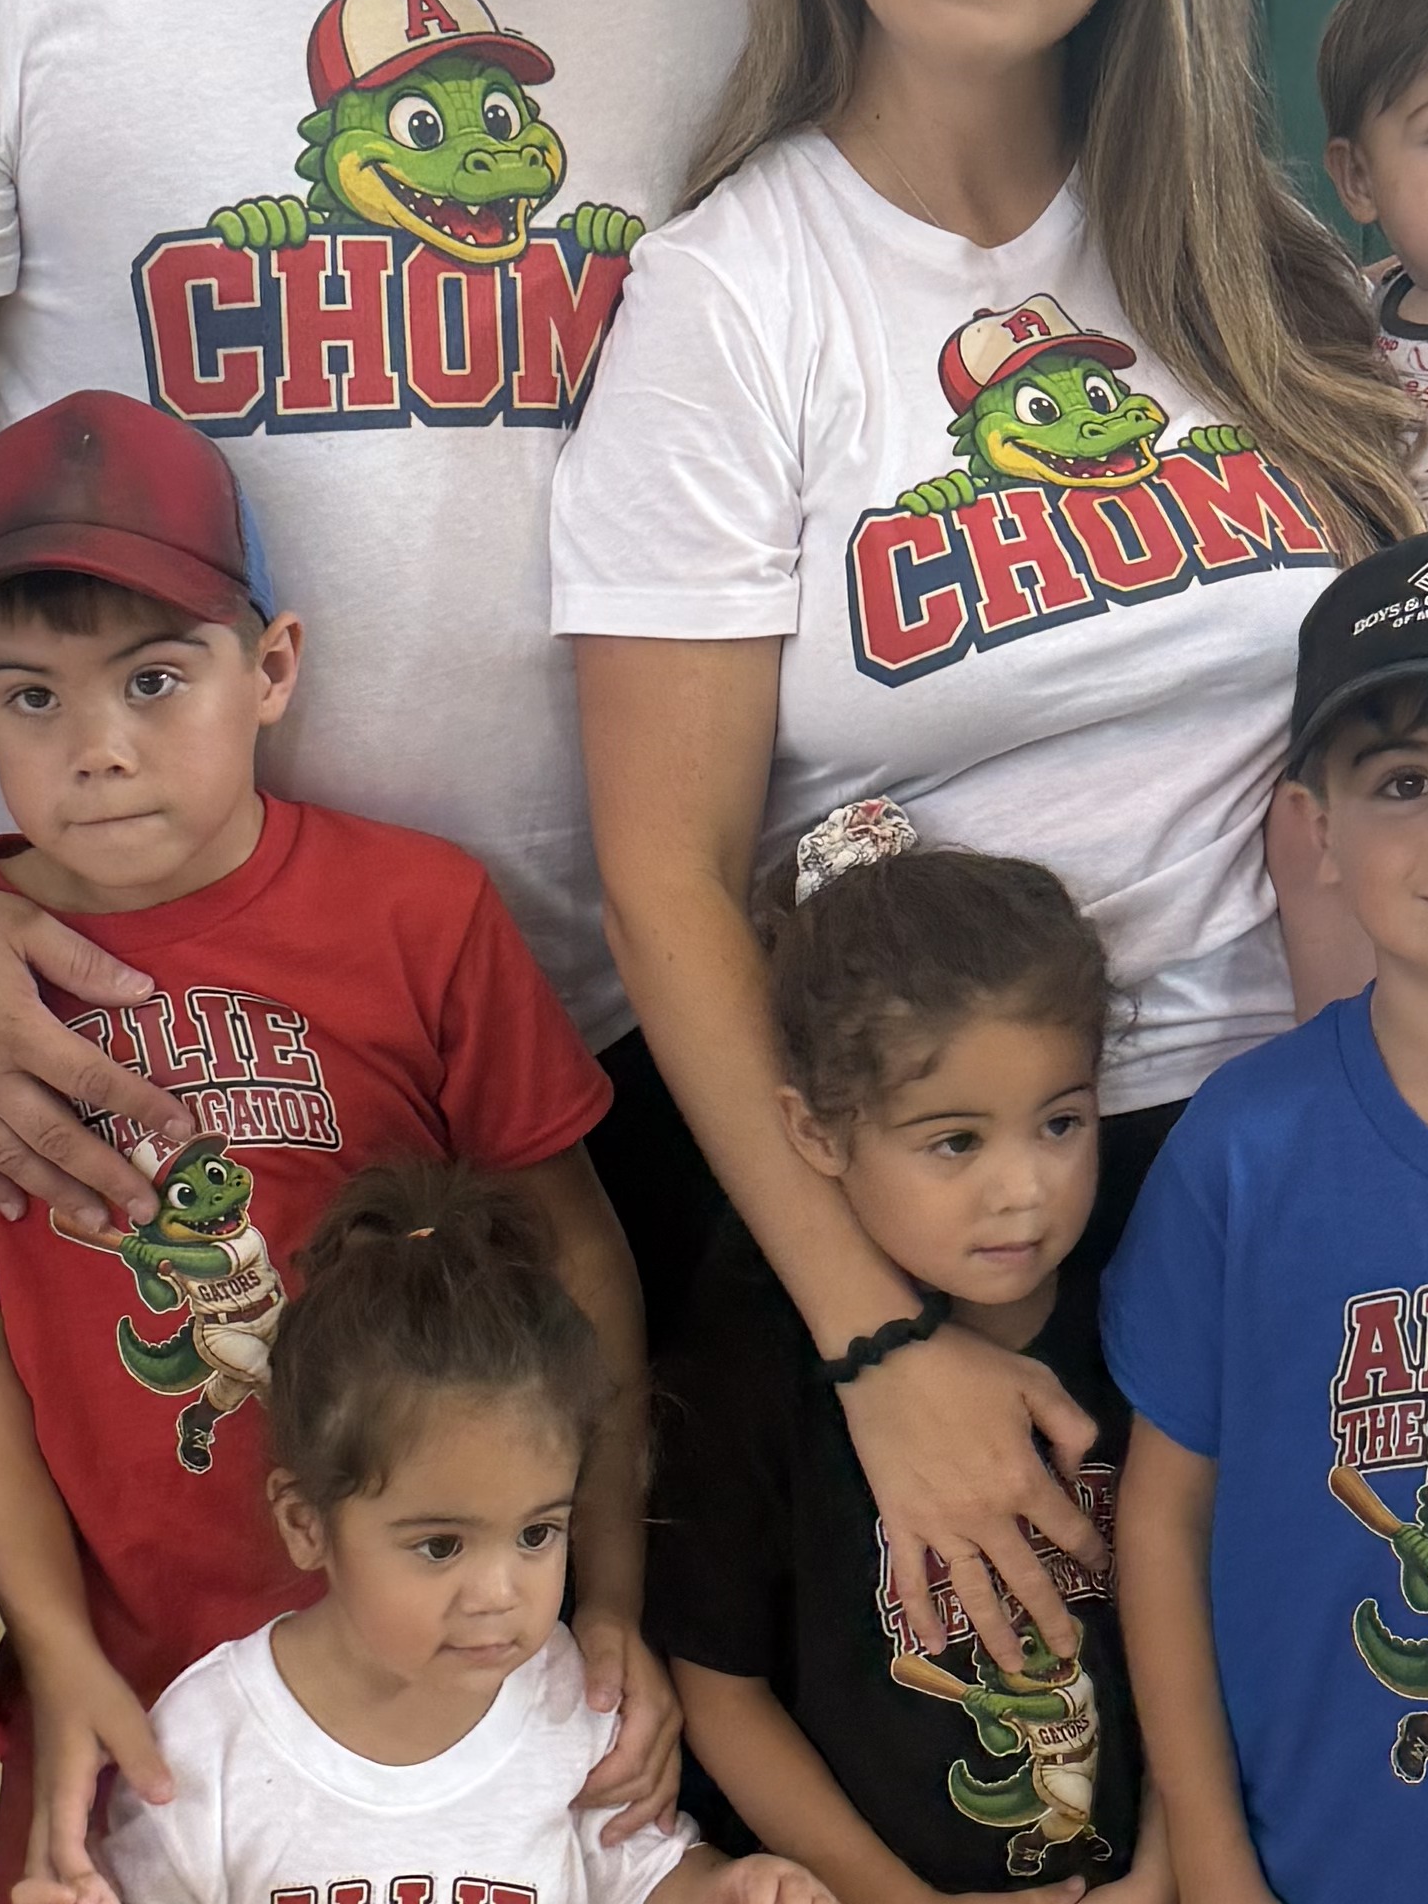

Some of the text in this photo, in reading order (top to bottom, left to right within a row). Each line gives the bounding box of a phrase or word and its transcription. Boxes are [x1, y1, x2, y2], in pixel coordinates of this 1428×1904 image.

[137, 231, 634, 426] CHOM
[1001, 307, 1052, 345] A
[852, 449, 1331, 671] CHOM
[1352, 603, 1401, 636] BOYS
[1404, 597, 1421, 612] &
[1392, 615, 1416, 628] OF
[151, 1132, 176, 1162] A
[196, 1270, 263, 1304] GATORS
[1337, 1400, 1425, 1467] THE
